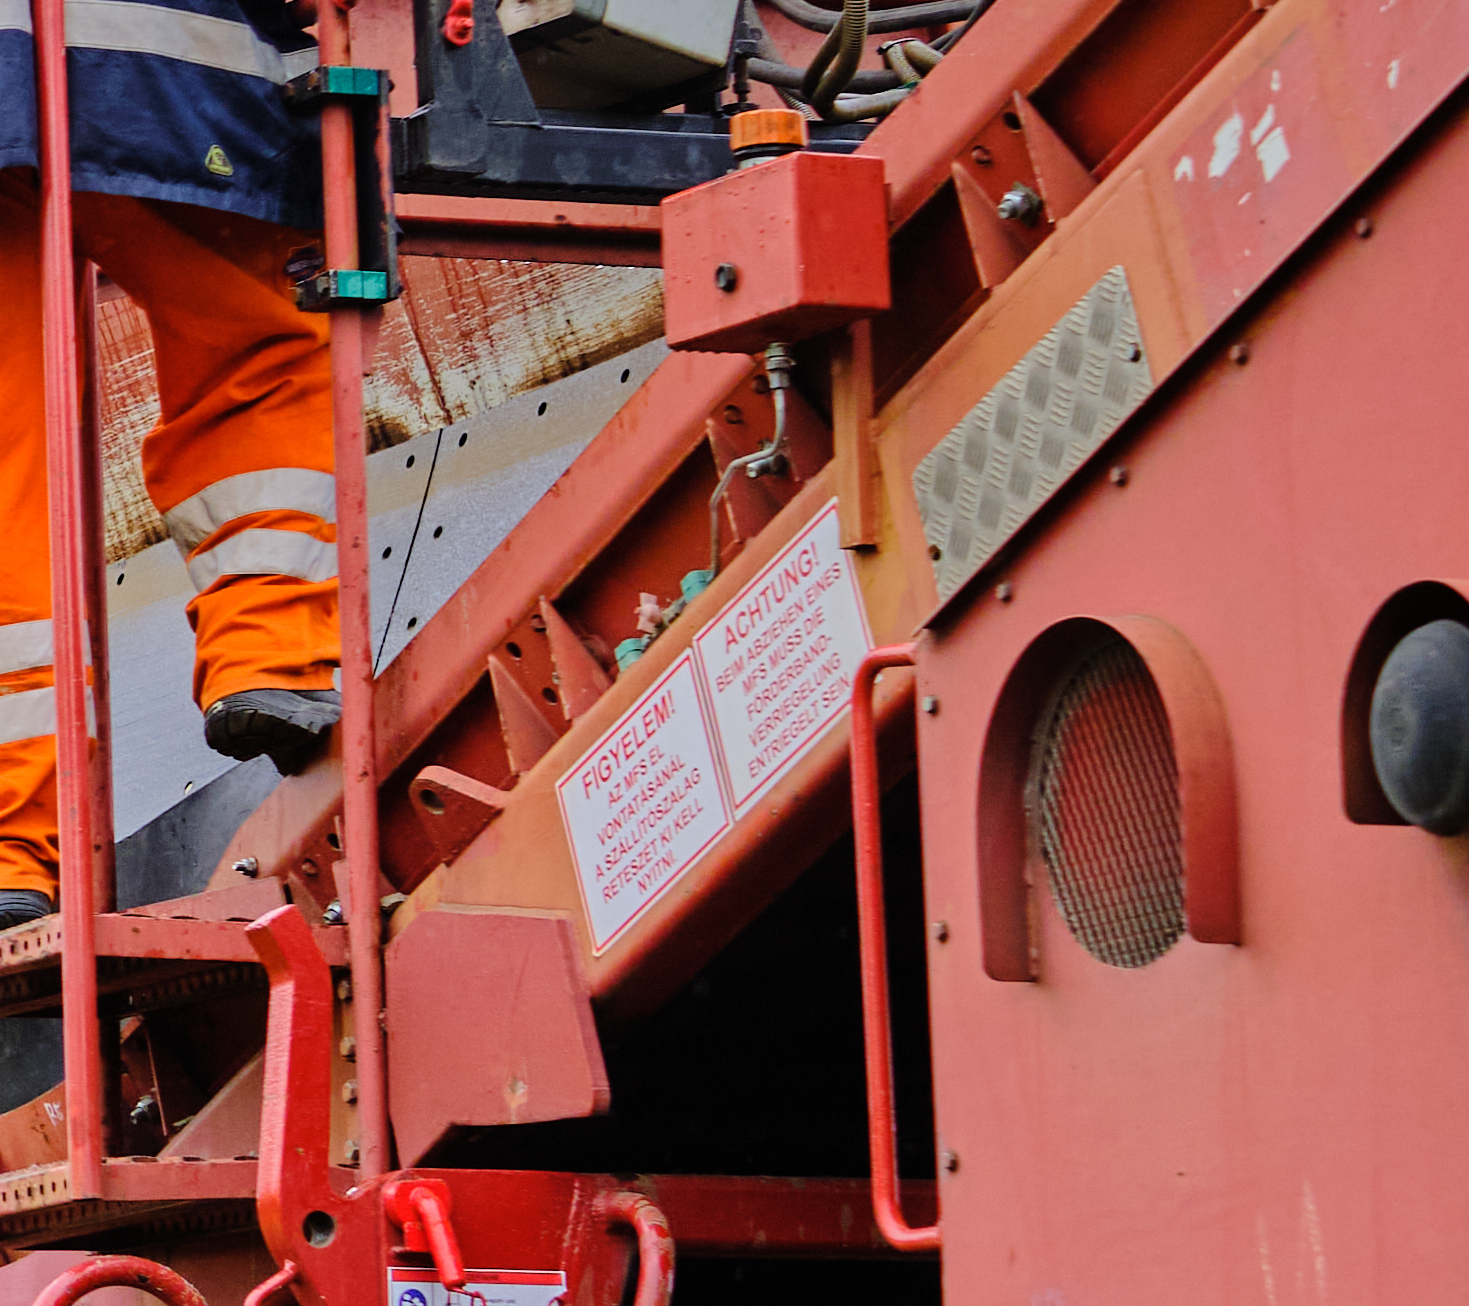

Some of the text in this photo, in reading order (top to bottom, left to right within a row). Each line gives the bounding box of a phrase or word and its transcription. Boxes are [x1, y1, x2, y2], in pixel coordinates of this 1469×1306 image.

[715, 562, 842, 693] BEIM ABZIEHEN EINES
[725, 541, 820, 655] ACHTUNG!
[742, 605, 826, 697] MFS MUSS DIE
[747, 635, 833, 722] FÖRDERBAND-
[748, 652, 842, 747] VERRIEGELUNG
[748, 699, 820, 779] ENTRIEGELT
[581, 690, 676, 799] FIGYELEM!
[608, 745, 666, 809] AZ MFS EL
[659, 825, 673, 849] KI
[672, 798, 704, 835] KELL
[595, 864, 605, 883] A
